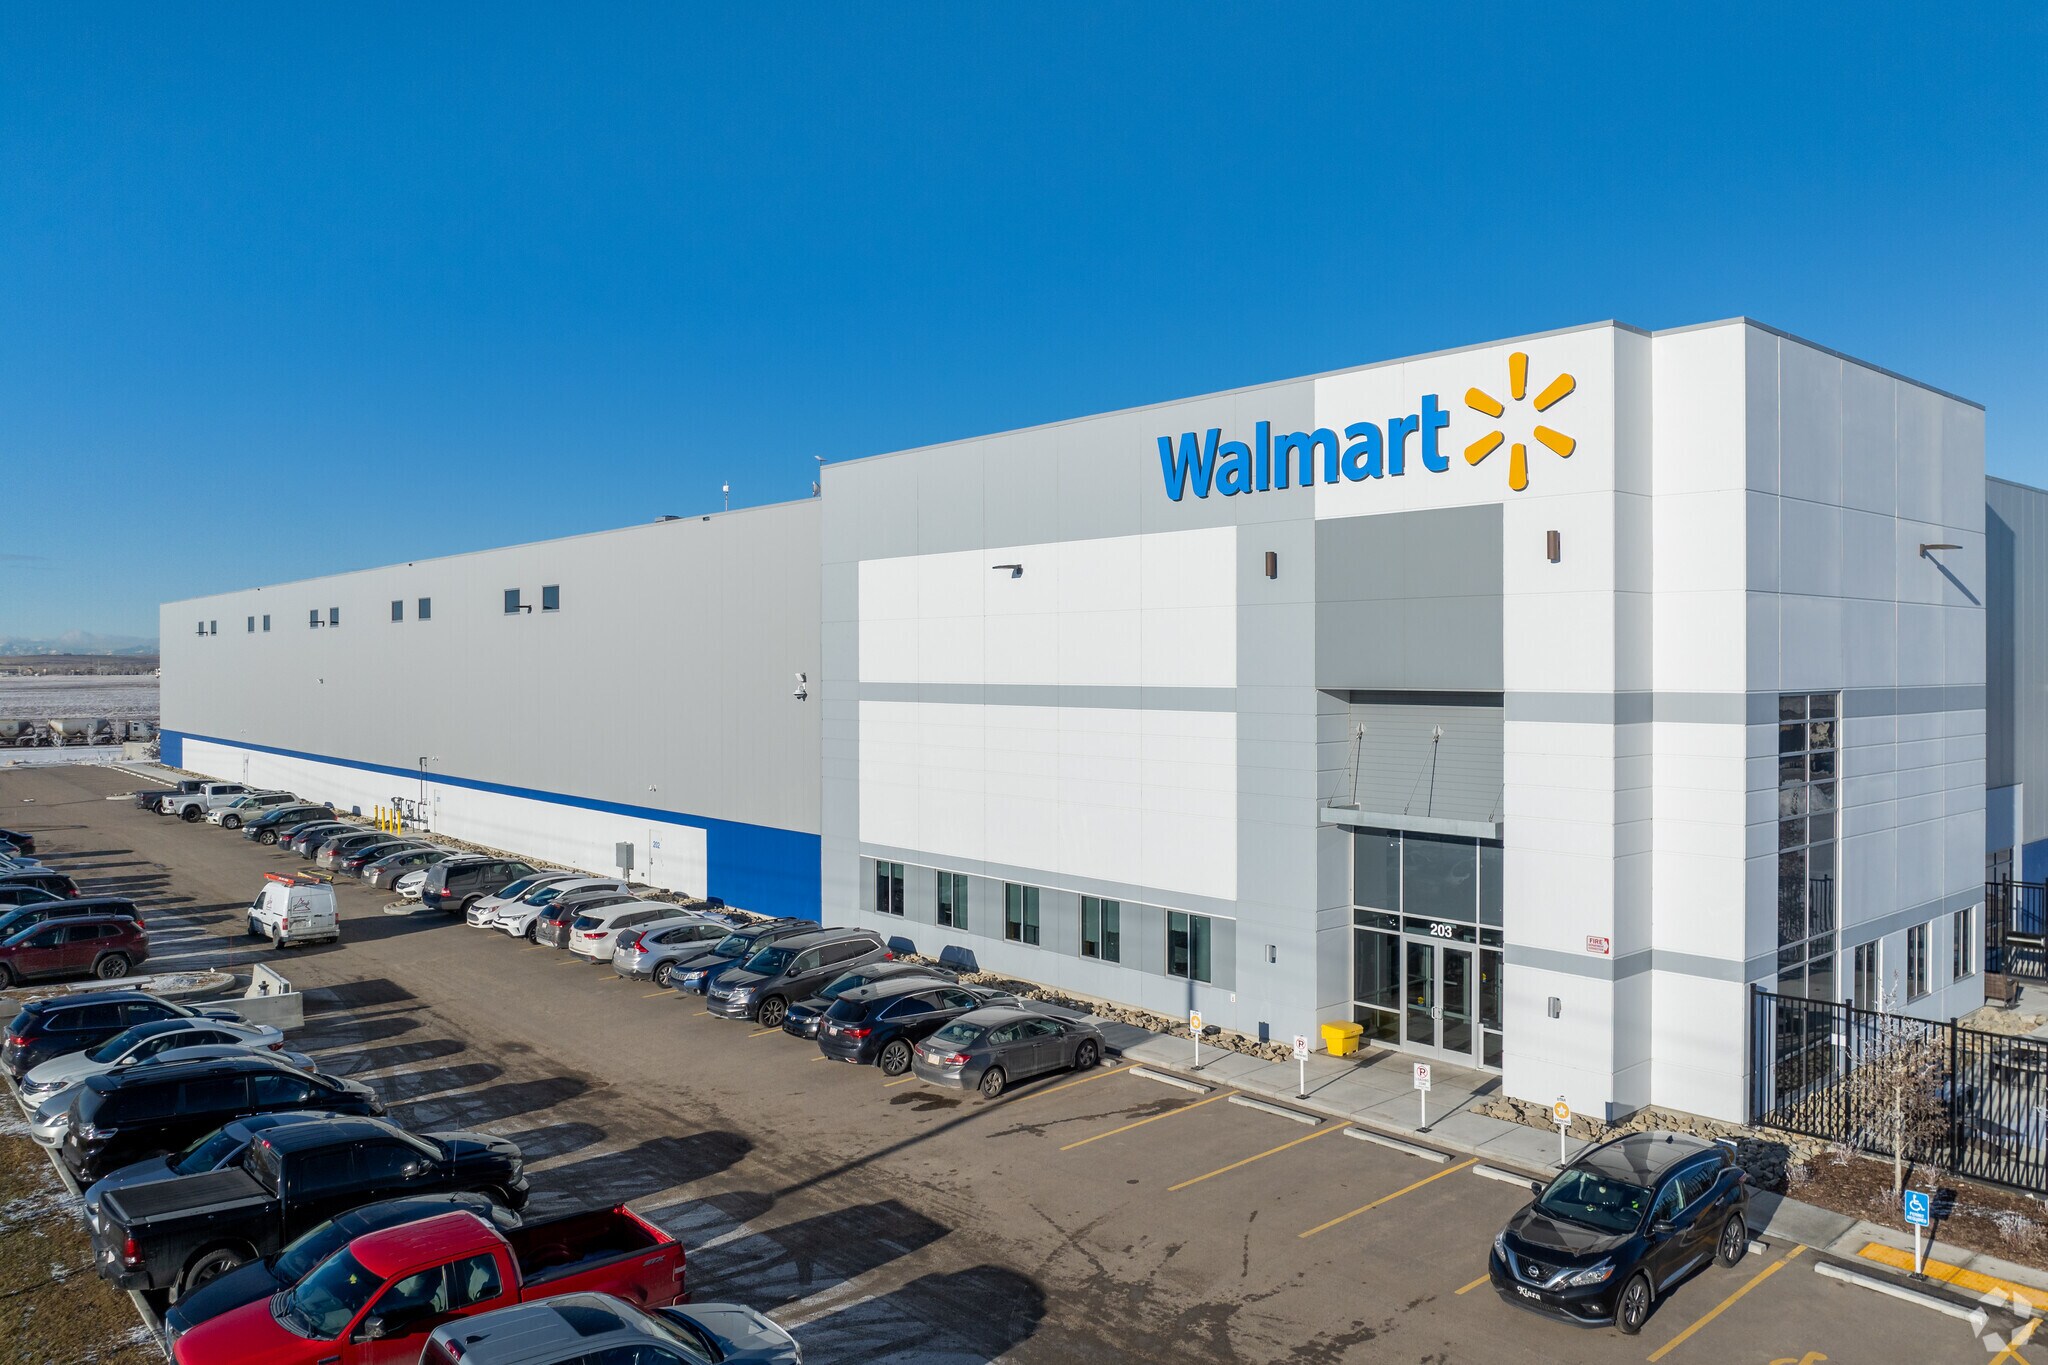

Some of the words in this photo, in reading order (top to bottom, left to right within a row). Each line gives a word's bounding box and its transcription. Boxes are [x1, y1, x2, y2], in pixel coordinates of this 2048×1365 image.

[1157, 393, 1451, 502] Walmart
[1430, 923, 1452, 938] 203
[1589, 937, 1603, 945] FIRE
[1516, 1285, 1541, 1301] Kiara
